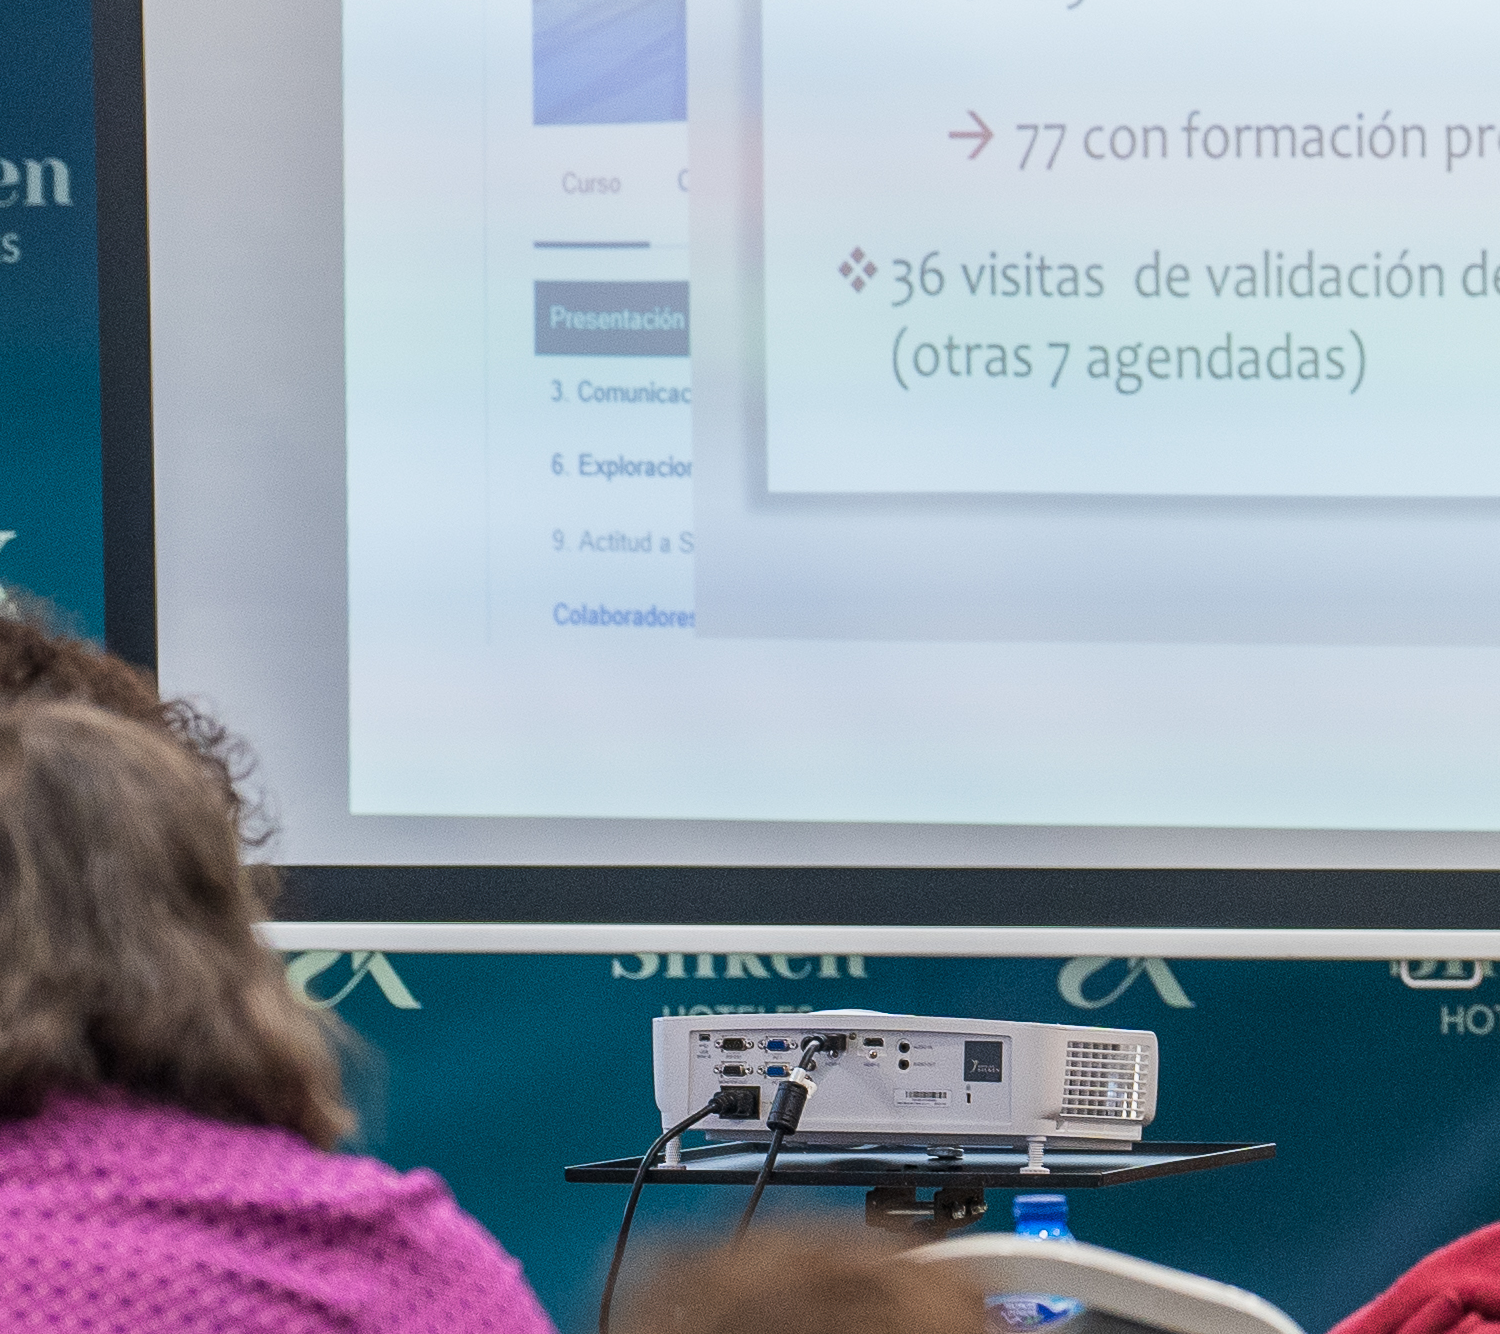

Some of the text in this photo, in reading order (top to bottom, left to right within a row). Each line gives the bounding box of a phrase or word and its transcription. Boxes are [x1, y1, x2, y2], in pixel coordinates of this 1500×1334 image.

[1015, 122, 1067, 172] 77
[1082, 124, 1169, 161] con
[1181, 109, 1428, 161] formación
[561, 170, 622, 195] Curso
[891, 250, 946, 308] 36
[960, 250, 1105, 299] visitas
[1133, 249, 1191, 300] de
[1205, 248, 1445, 300] validación
[548, 302, 687, 334] Presentación
[891, 326, 1367, 397] (otras 7 agendadas)
[551, 378, 569, 404] 3.
[551, 454, 570, 477] 6.
[579, 530, 652, 554] Actitud
[660, 536, 671, 554] a
